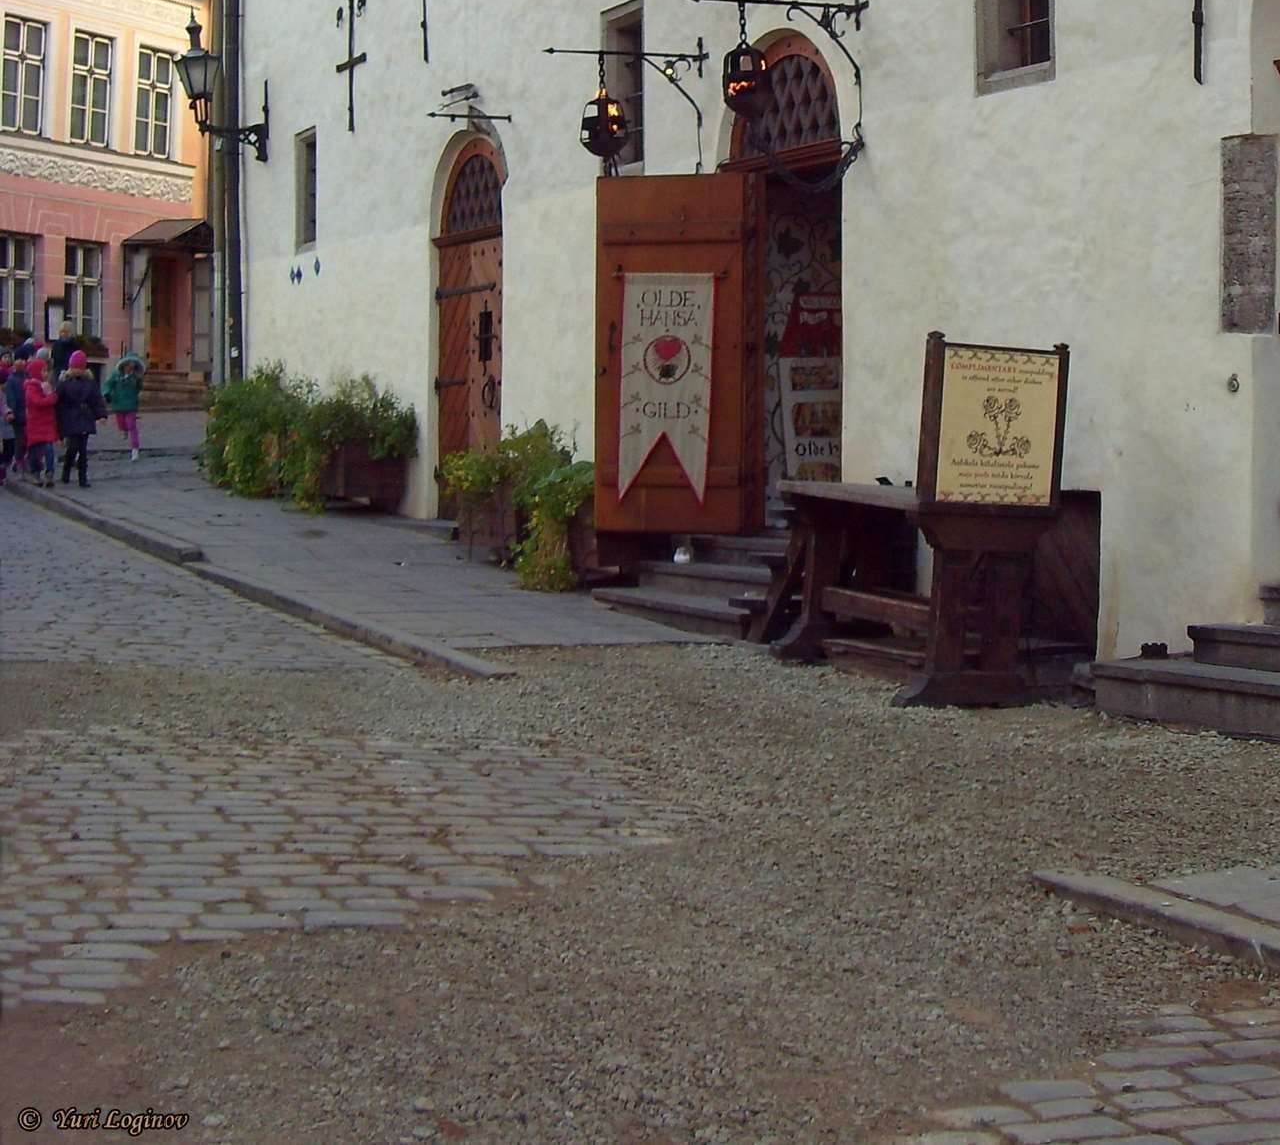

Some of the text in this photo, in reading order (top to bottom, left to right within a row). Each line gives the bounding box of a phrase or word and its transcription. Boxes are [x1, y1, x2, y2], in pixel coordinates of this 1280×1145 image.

[641, 290, 697, 308] OLDE
[639, 309, 699, 327] HANSA
[951, 363, 1016, 374] COMPLIMENTARY
[642, 401, 691, 420] GILD
[795, 441, 825, 457] Olde
